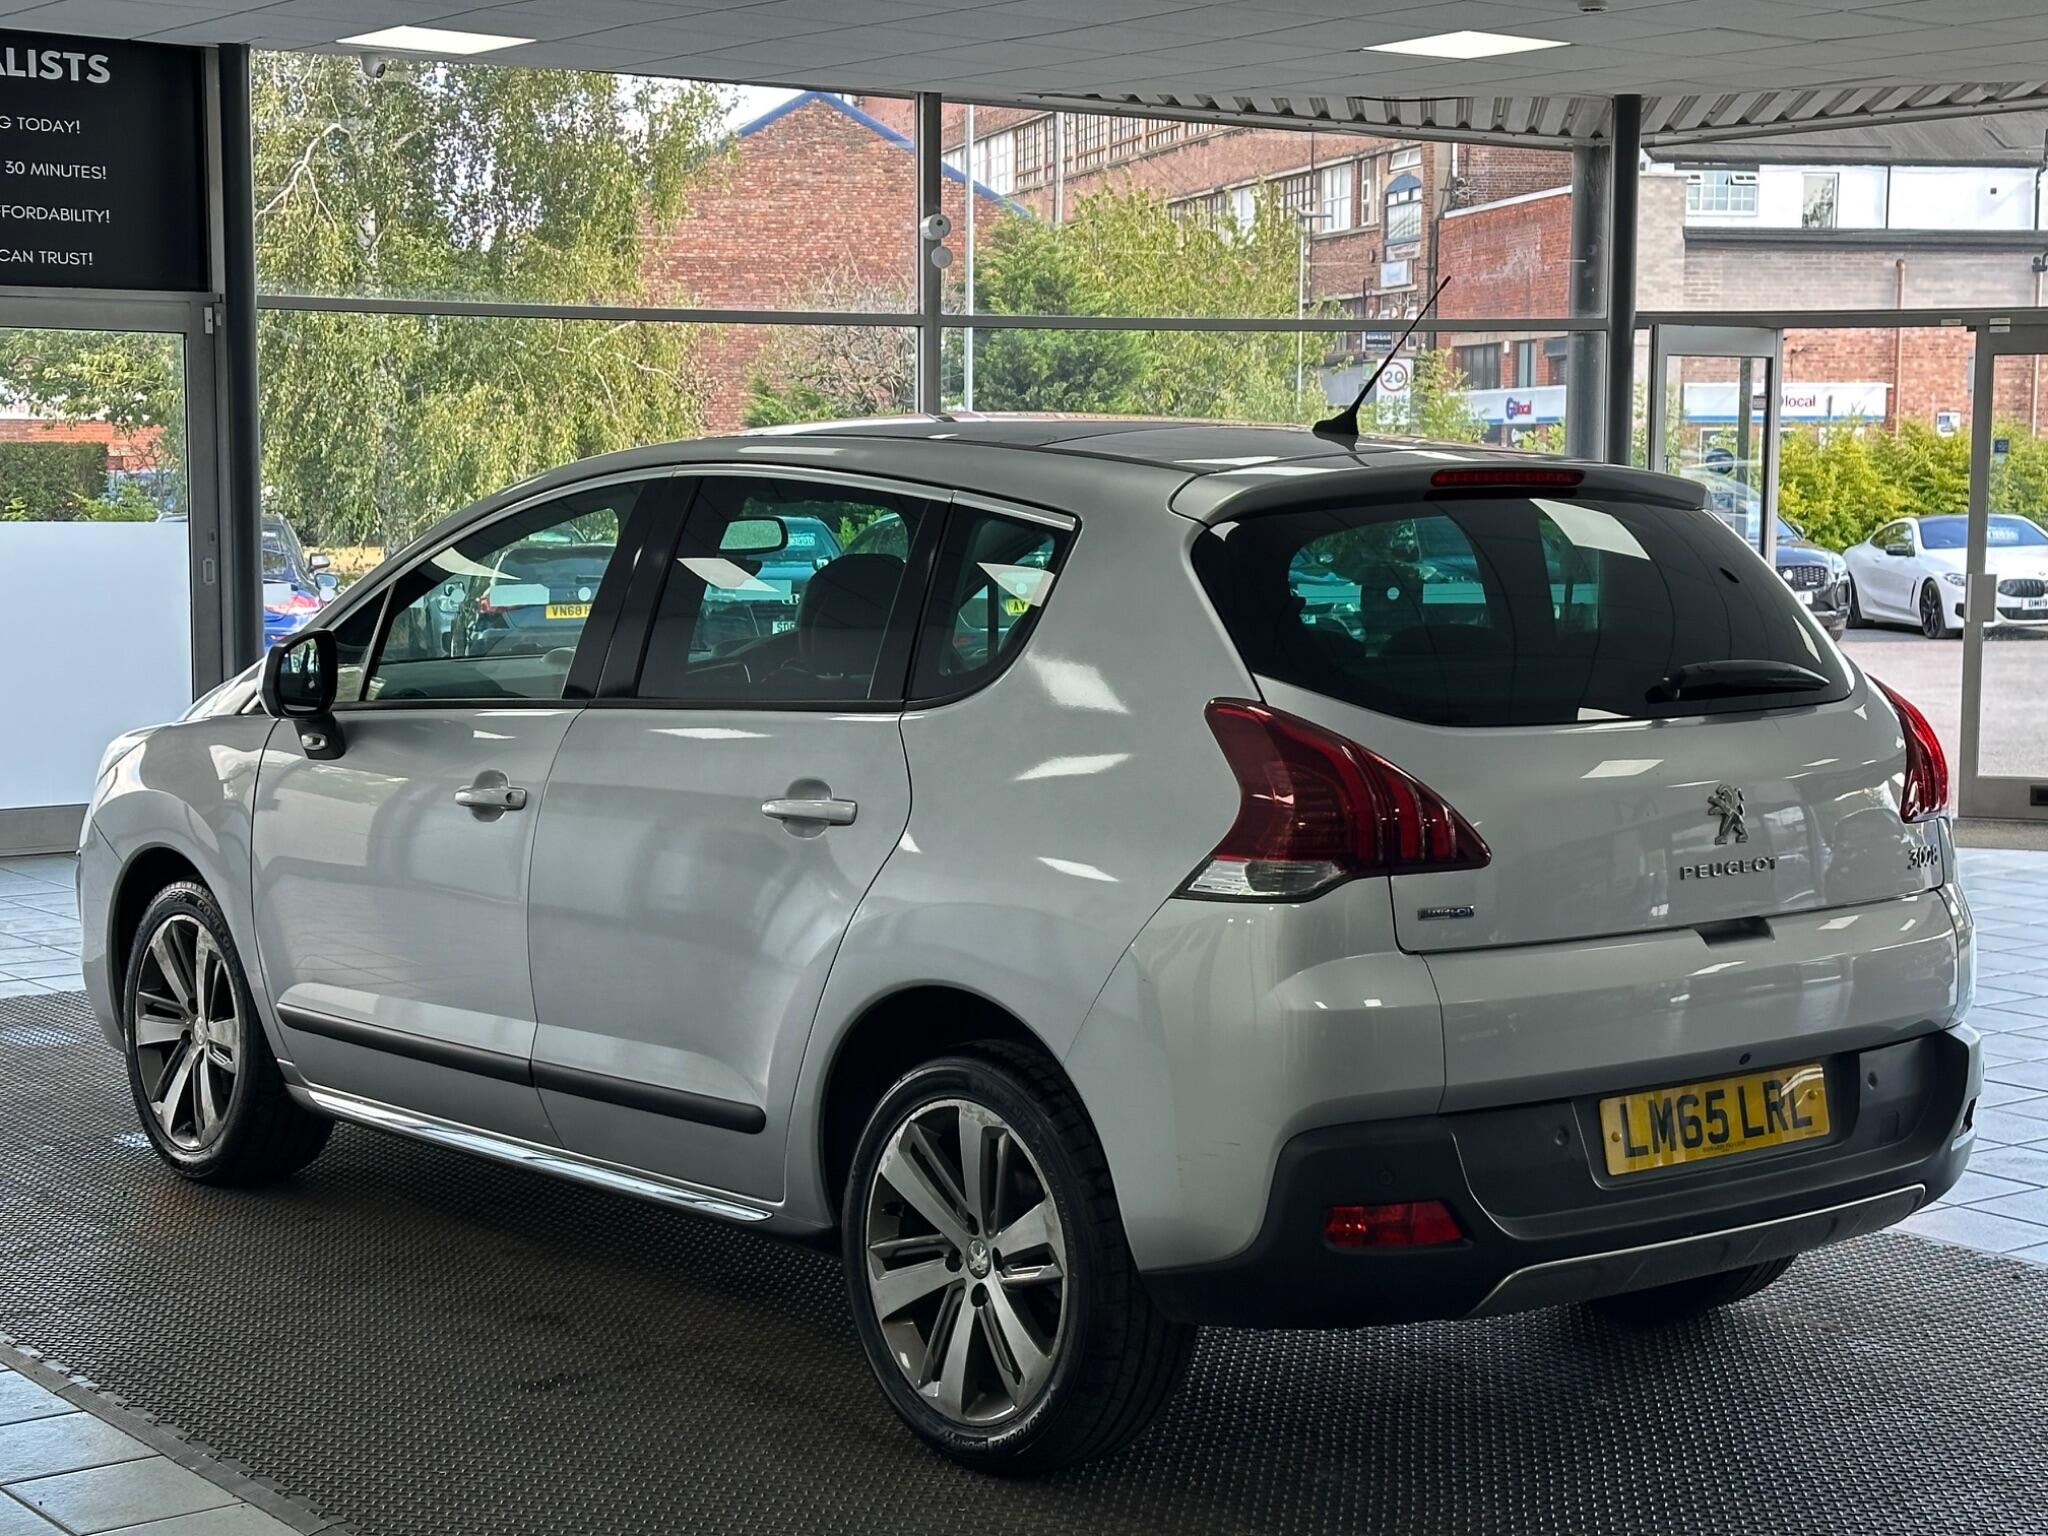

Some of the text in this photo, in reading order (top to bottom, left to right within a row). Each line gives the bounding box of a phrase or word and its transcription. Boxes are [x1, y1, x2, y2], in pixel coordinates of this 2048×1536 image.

[16, 116, 81, 134] TODAY!
[5, 160, 107, 180] 30 MINUTES!
[0, 204, 110, 224] FORDABILITY!
[38, 250, 93, 266] TRUST!
[1383, 370, 1404, 384] 20
[1785, 394, 1816, 408] local
[1679, 856, 1777, 881] PEUGEOT
[1619, 1075, 1814, 1159] LM65 LRL
